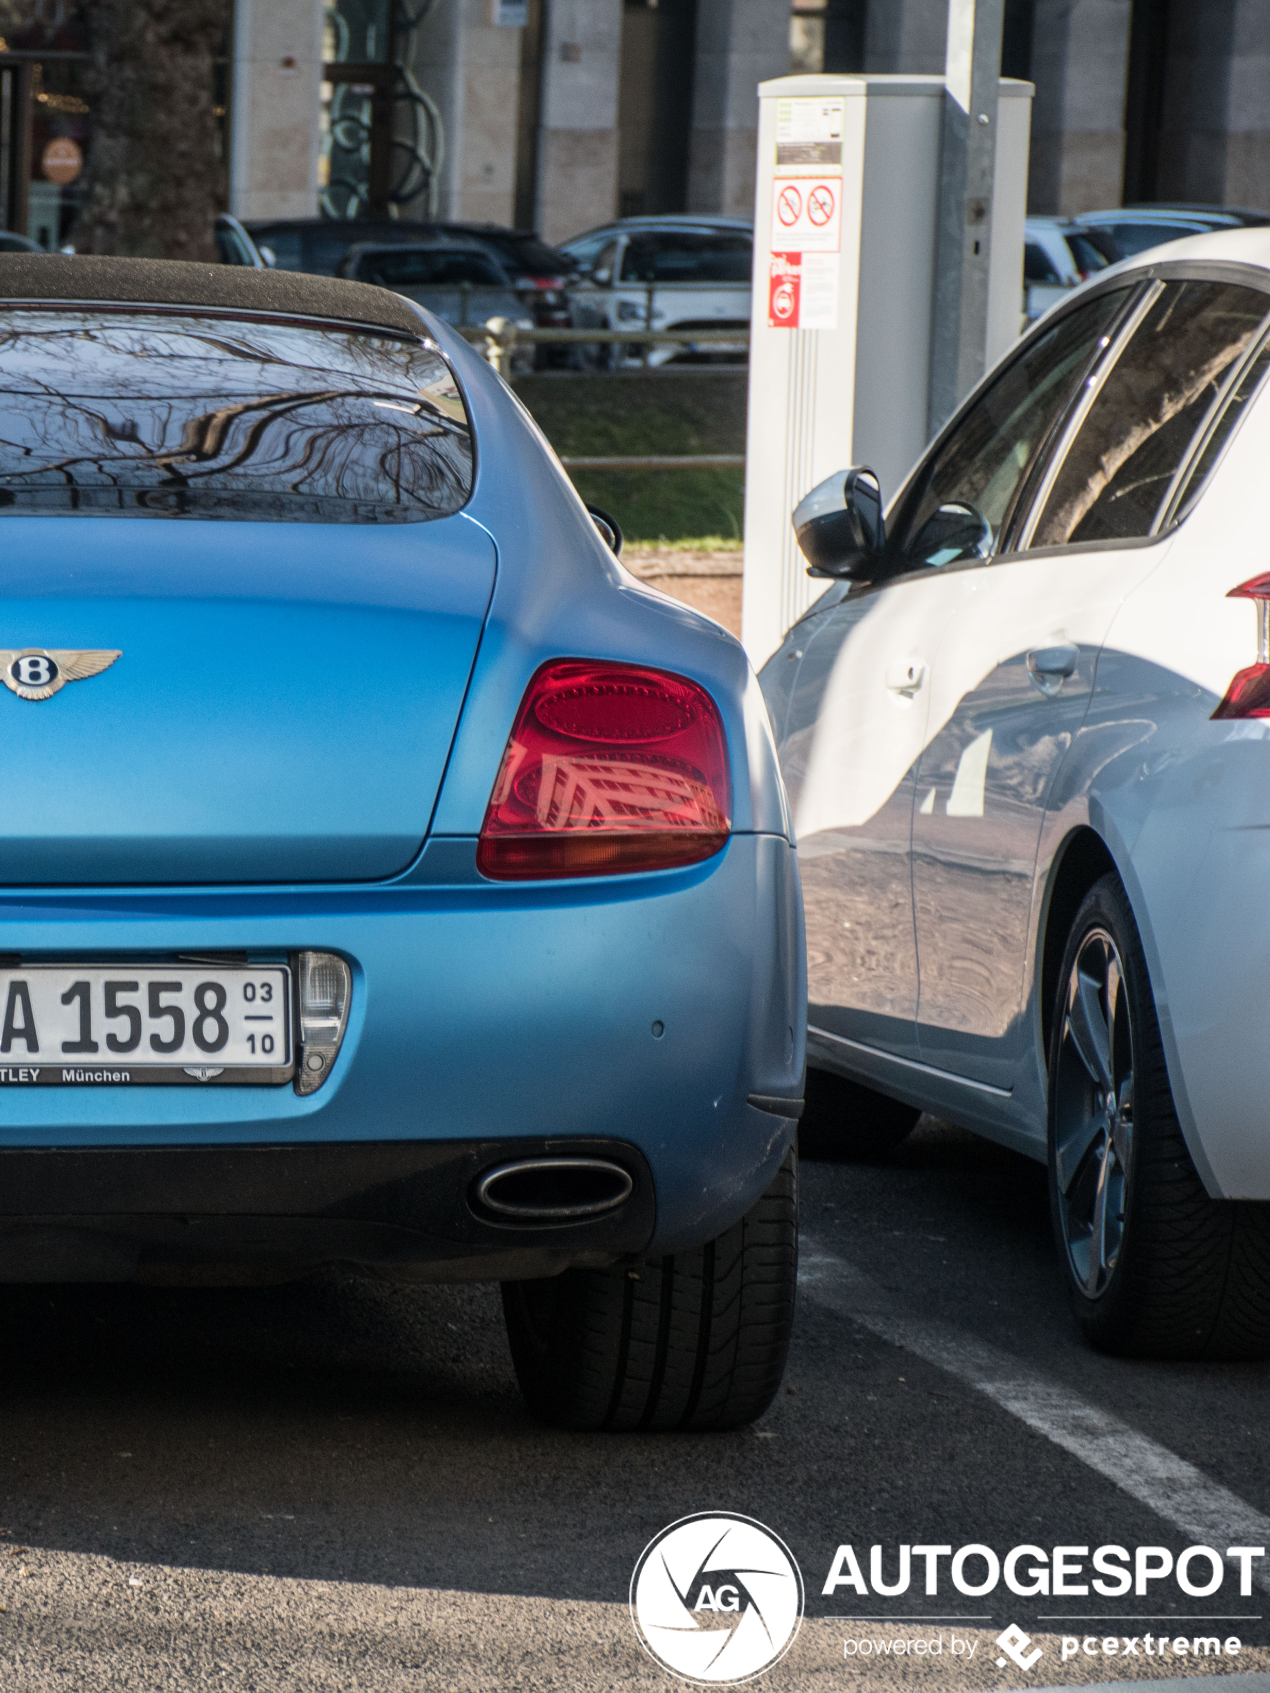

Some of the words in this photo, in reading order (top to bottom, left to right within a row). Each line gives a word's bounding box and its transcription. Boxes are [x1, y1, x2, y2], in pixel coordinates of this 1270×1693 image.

[18, 656, 51, 685] B
[243, 982, 273, 1002] 03
[61, 981, 229, 1054] 1558
[246, 1034, 275, 1054] 10
[62, 1069, 130, 1082] München
